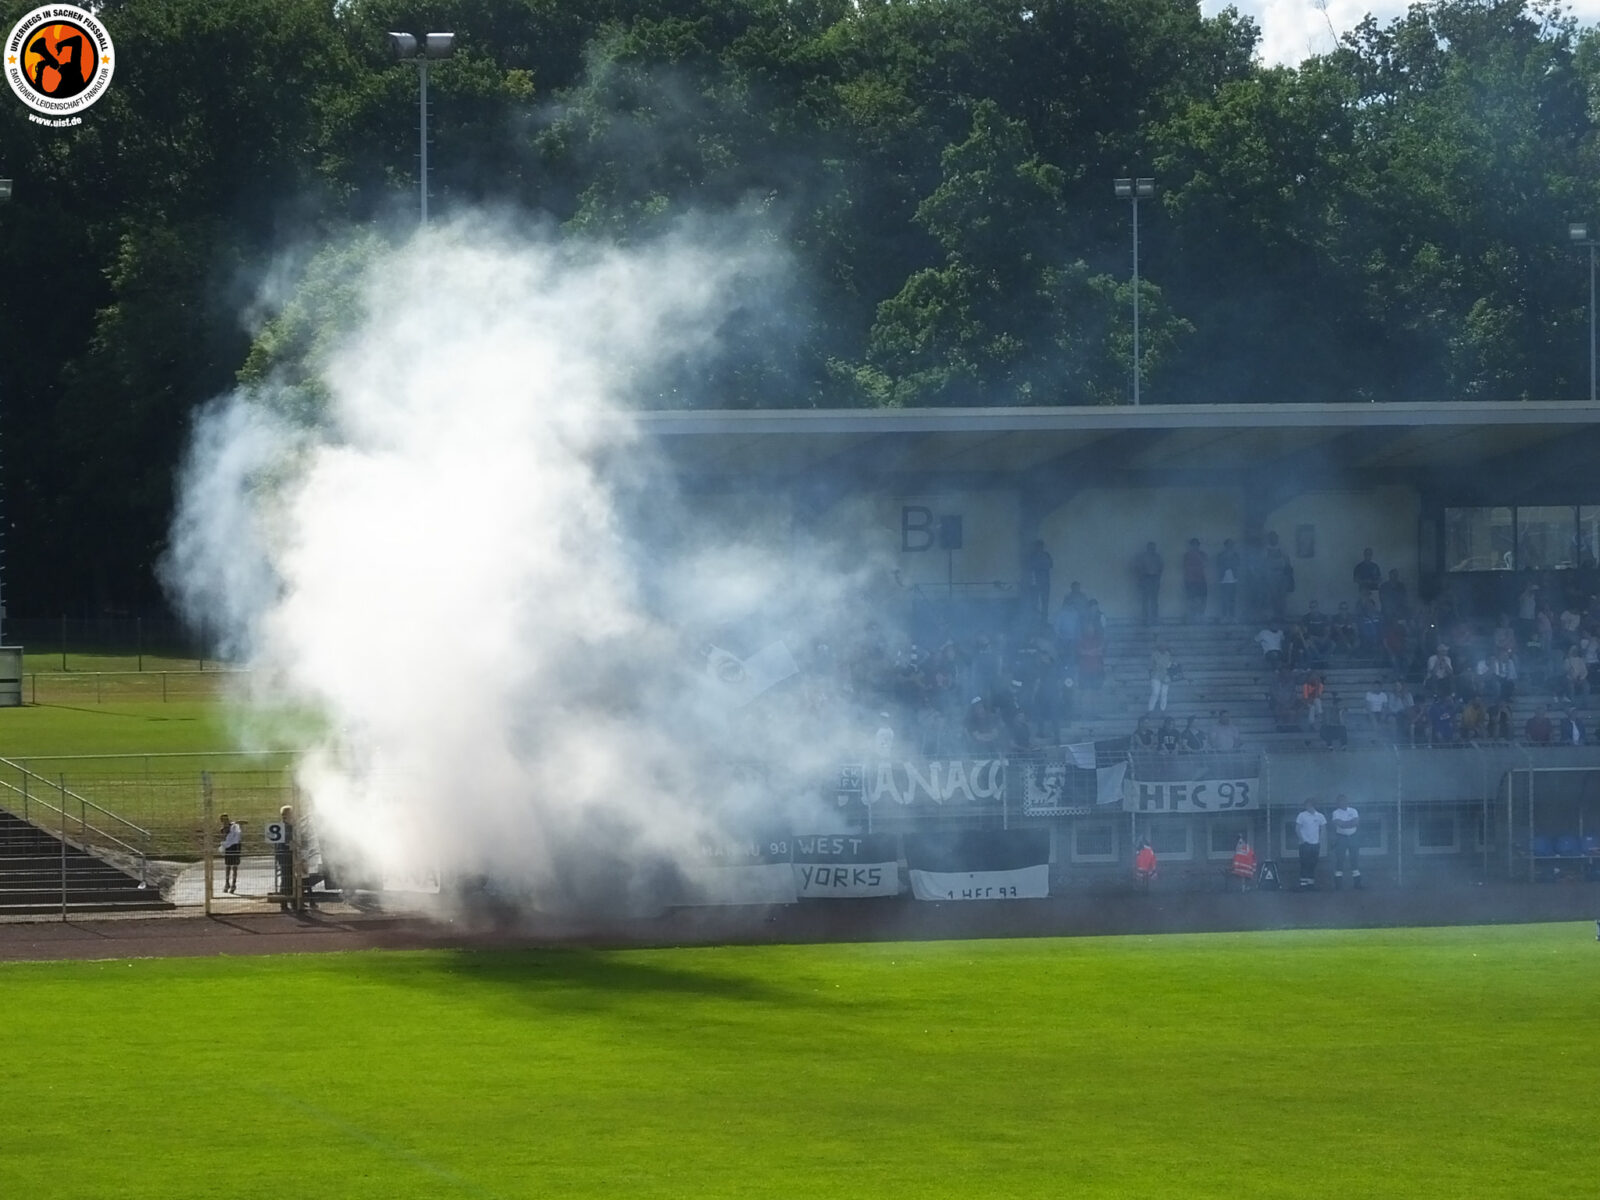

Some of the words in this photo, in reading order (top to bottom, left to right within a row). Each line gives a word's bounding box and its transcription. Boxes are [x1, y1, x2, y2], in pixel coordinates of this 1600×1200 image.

[902, 506, 935, 552] B
[1139, 783, 1208, 809] HFC
[1217, 782, 1250, 809] 93
[769, 841, 788, 855] 93
[798, 837, 862, 855] WEST
[801, 866, 881, 890] YORKS
